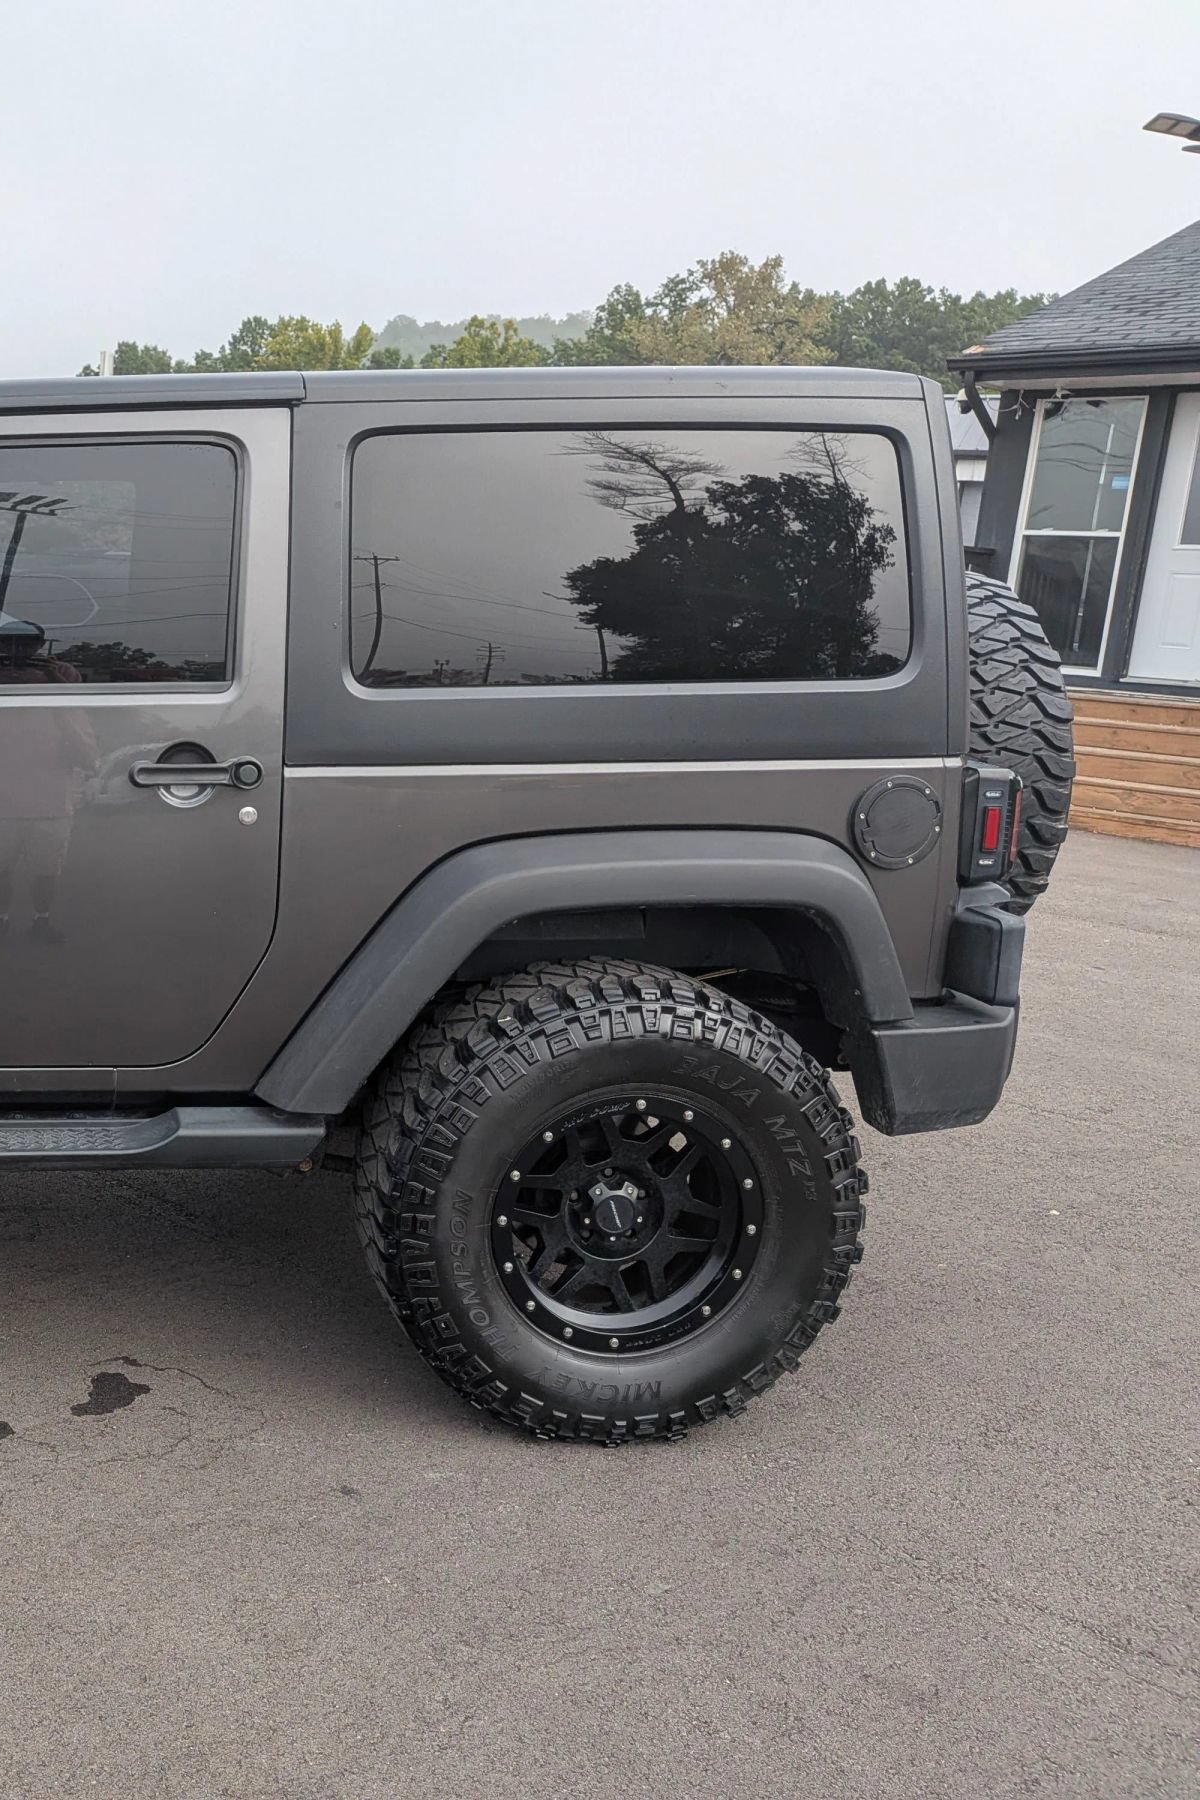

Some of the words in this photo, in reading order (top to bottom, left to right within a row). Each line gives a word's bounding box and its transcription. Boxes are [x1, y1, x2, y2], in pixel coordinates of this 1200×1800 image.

[671, 1055, 762, 1108] BAJA
[450, 1187, 520, 1363] THOMPSON
[525, 1366, 665, 1402] MICKEY
